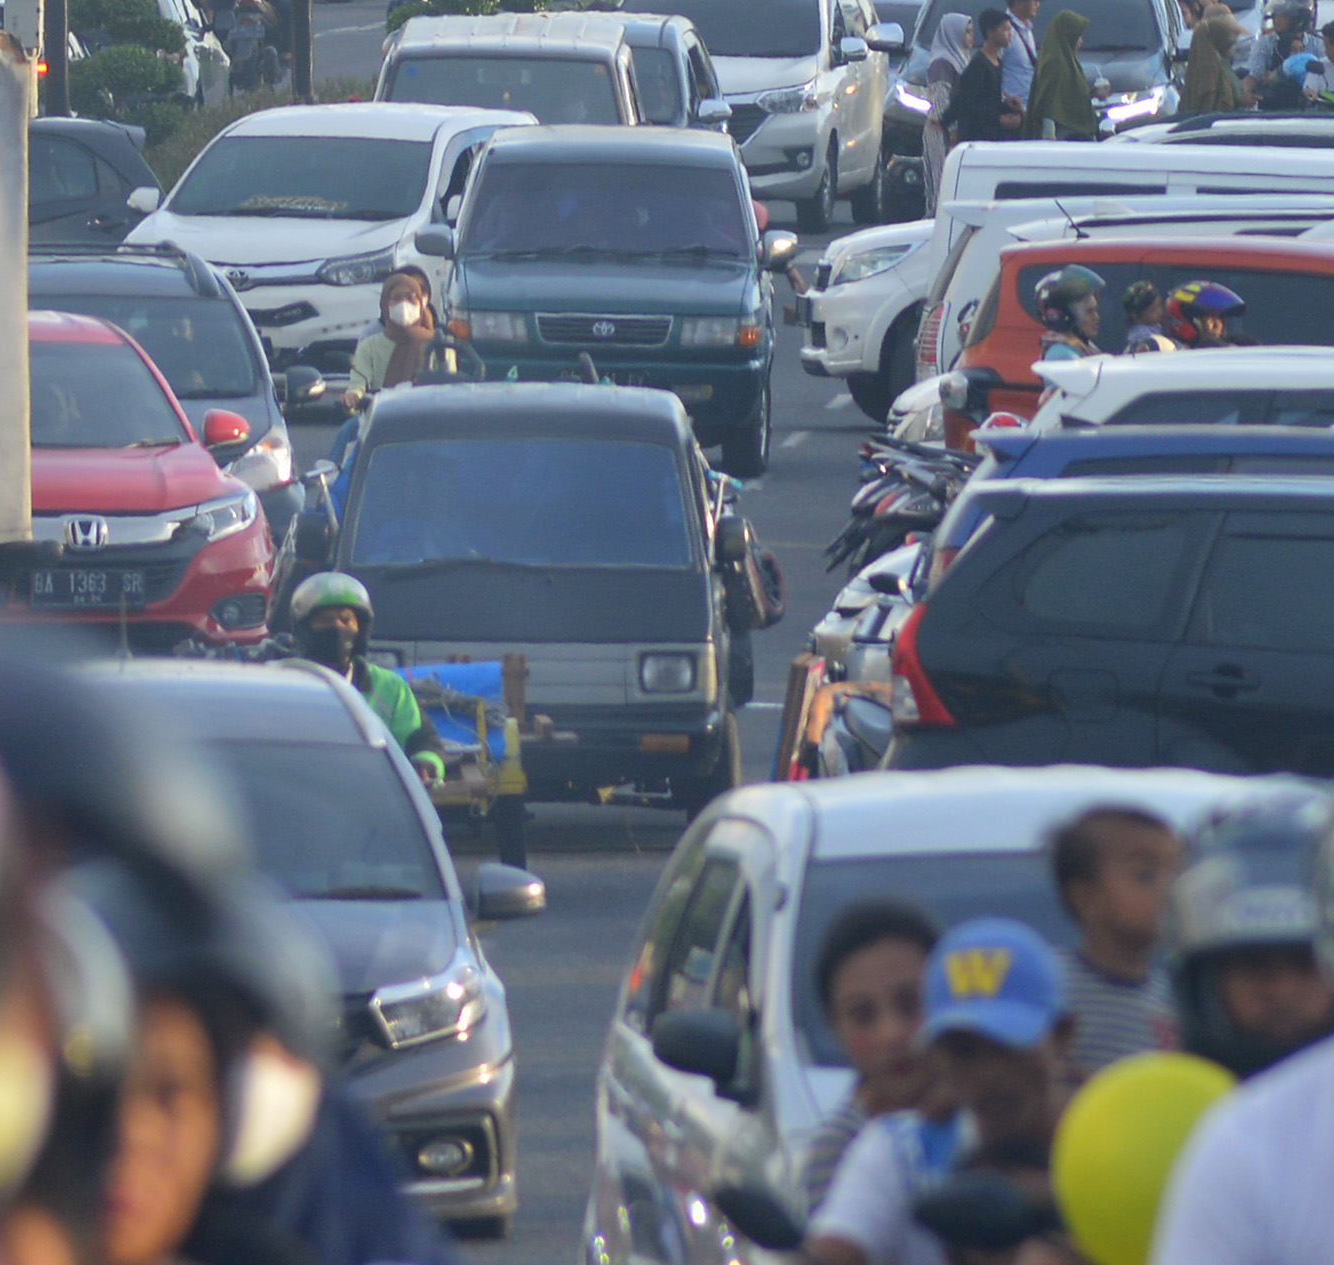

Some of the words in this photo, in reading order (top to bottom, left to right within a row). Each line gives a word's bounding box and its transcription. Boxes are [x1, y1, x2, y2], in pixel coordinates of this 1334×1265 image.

[34, 572, 54, 594] BA
[69, 571, 107, 593] 1363
[123, 572, 143, 592] SR
[945, 948, 1010, 996] W
